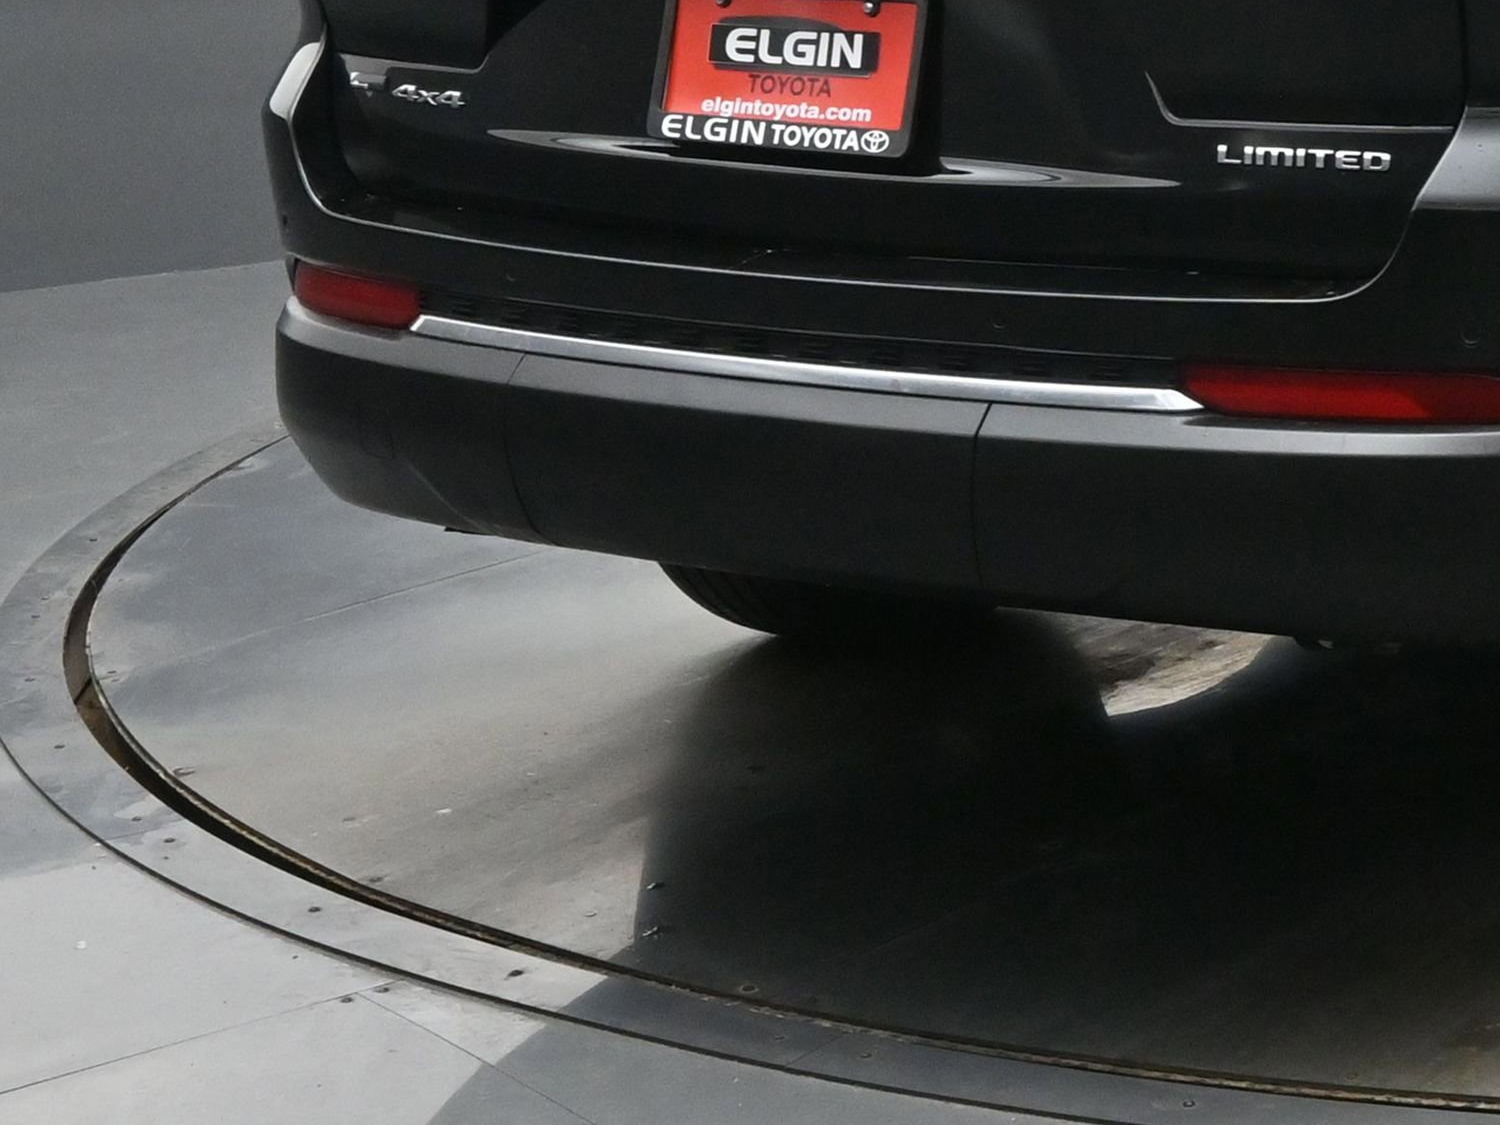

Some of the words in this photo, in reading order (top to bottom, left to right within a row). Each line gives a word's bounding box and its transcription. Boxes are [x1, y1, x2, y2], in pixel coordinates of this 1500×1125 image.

[725, 28, 863, 69] ELGIN
[392, 84, 466, 108] 4x4
[748, 74, 832, 98] TOYOTA
[701, 96, 872, 123] elgintoyota.com
[661, 114, 766, 145] ELGIN
[771, 124, 860, 151] TOYOTA
[1217, 144, 1391, 171] LIMITED
